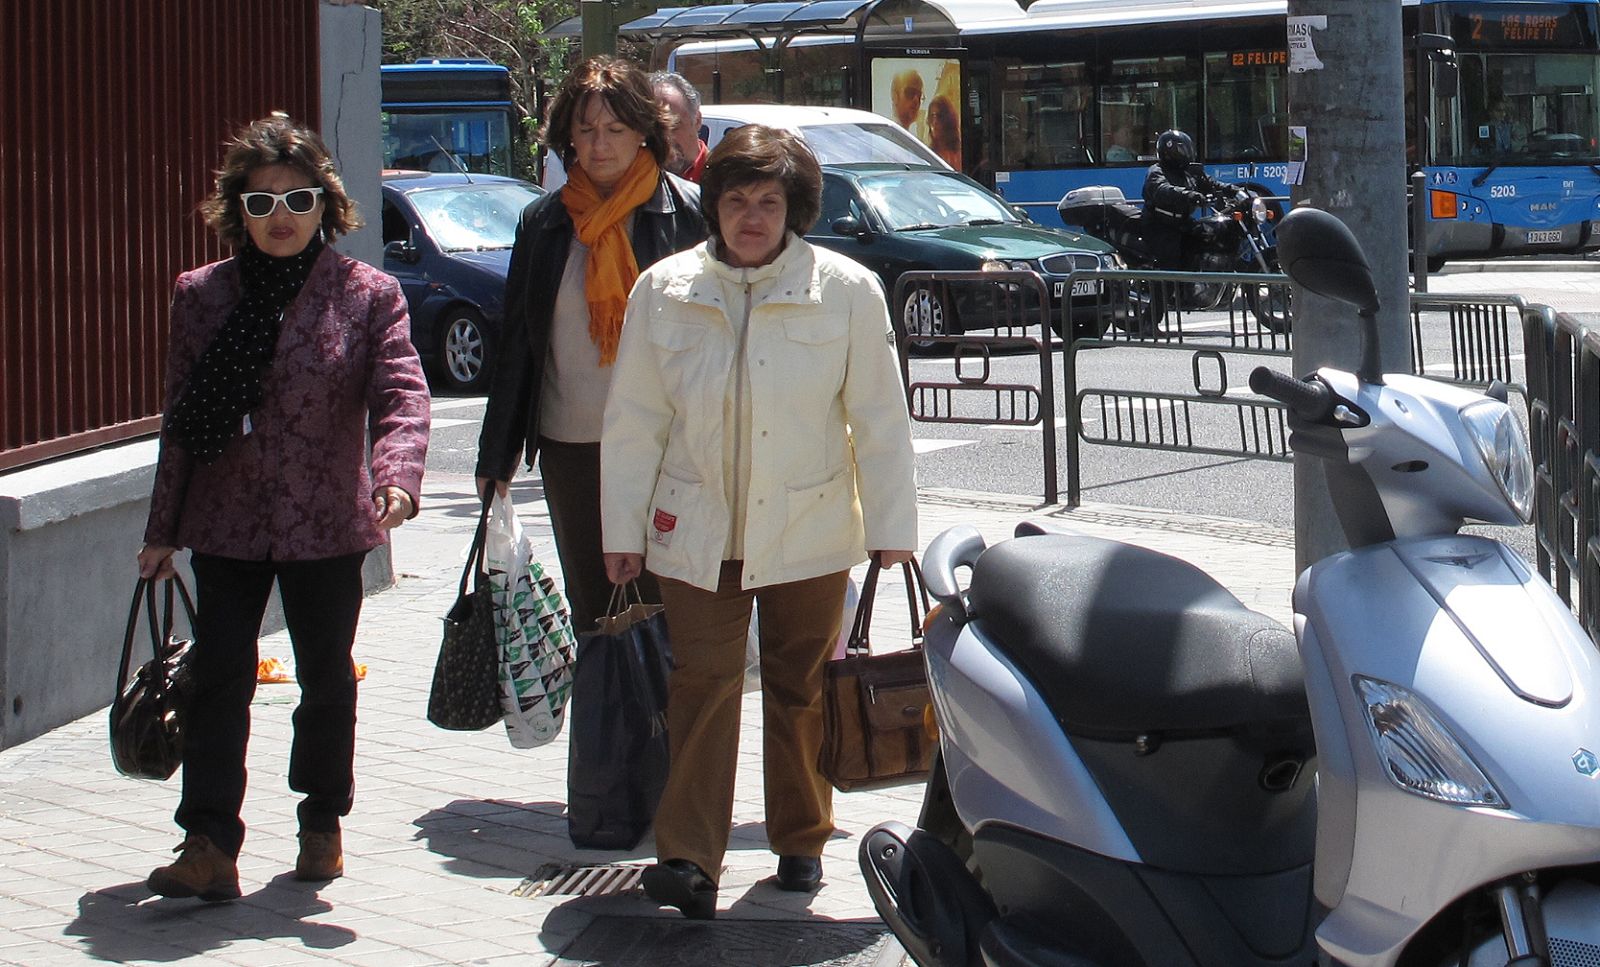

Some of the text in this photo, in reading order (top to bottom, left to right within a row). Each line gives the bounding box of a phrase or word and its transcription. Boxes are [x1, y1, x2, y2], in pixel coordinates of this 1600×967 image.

[1472, 14, 1482, 39] 2
[1247, 51, 1286, 64] FELIPE
[1263, 166, 1287, 177] 5203
[1490, 185, 1516, 198] 5203
[1529, 203, 1557, 211] MAN
